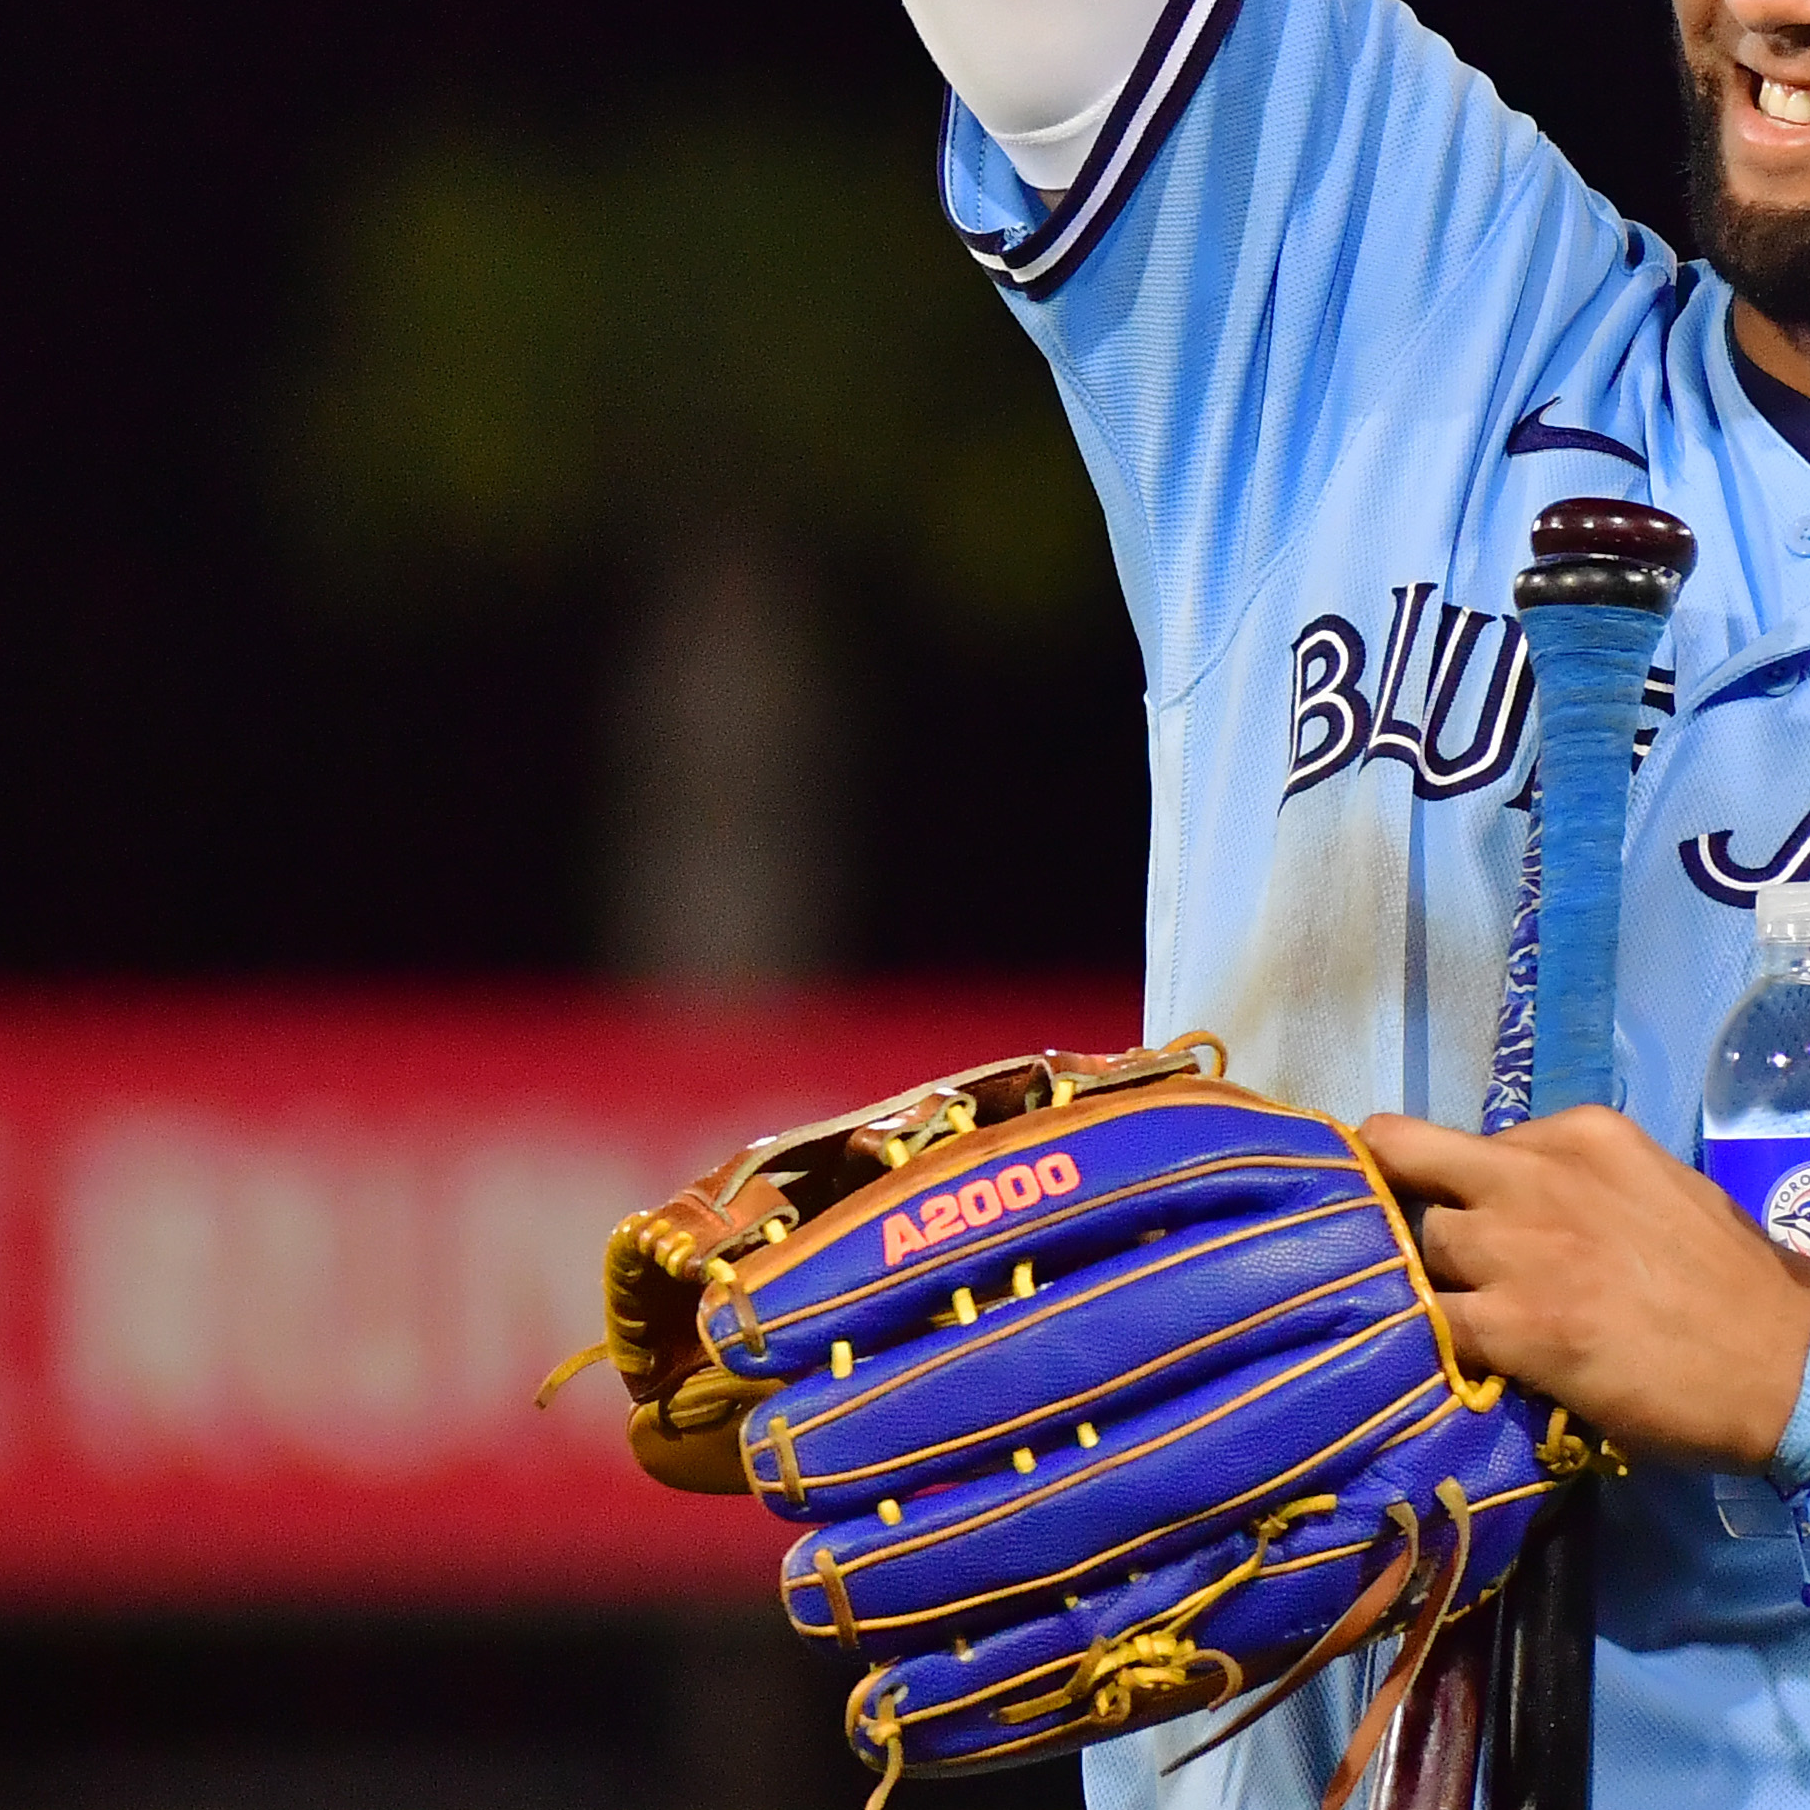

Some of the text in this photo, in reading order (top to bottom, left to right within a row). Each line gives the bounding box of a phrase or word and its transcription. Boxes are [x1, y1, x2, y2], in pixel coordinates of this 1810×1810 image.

[1279, 581, 1676, 813] BLU
[60, 1100, 780, 1470] RUN
[882, 1152, 1082, 1267] A2000
